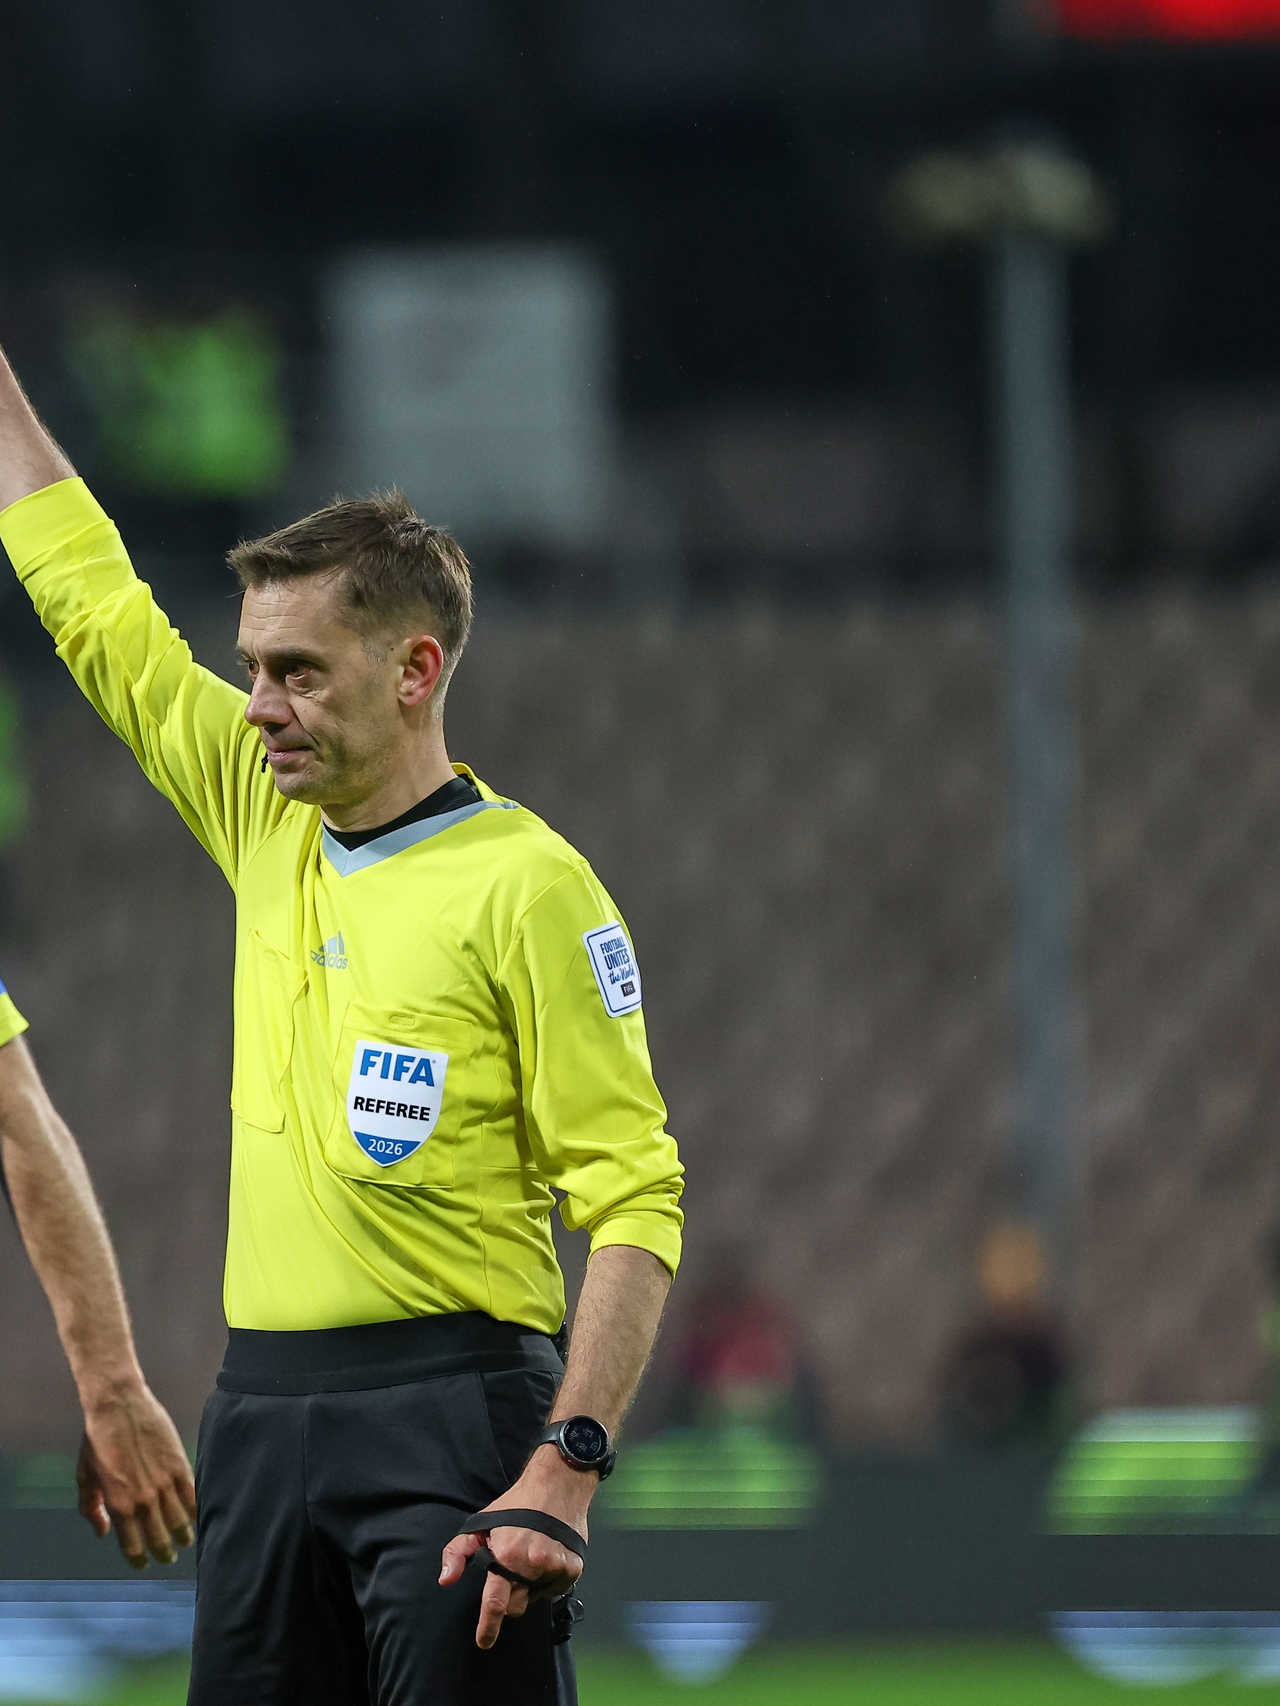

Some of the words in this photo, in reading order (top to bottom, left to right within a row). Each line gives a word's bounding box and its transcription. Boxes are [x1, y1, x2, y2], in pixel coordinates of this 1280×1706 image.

[600, 936, 625, 955] FOOTBALL
[604, 948, 630, 970] UNITES
[608, 970, 621, 985] the
[360, 1049, 435, 1087] FIFA
[353, 1096, 431, 1121] REFEREE
[367, 1139, 403, 1156] 2026
